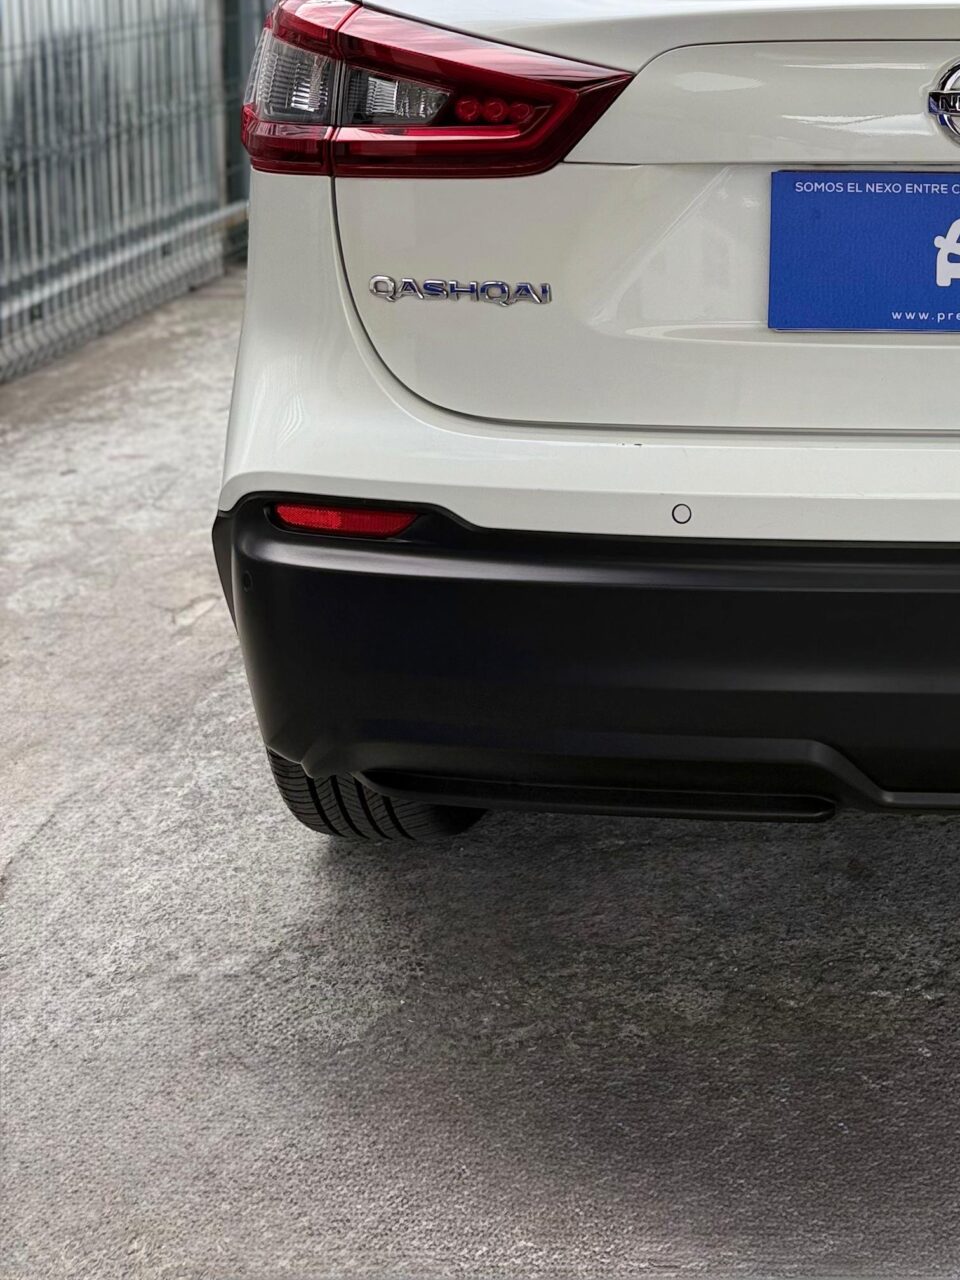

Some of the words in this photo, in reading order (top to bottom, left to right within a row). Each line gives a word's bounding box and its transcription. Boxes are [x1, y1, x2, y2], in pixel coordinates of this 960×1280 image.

[795, 182, 844, 193] SOMOS
[847, 182, 862, 193] EL
[865, 183, 902, 193] NEXO
[905, 183, 948, 194] ENTRE
[368, 274, 553, 308] QASHQAI
